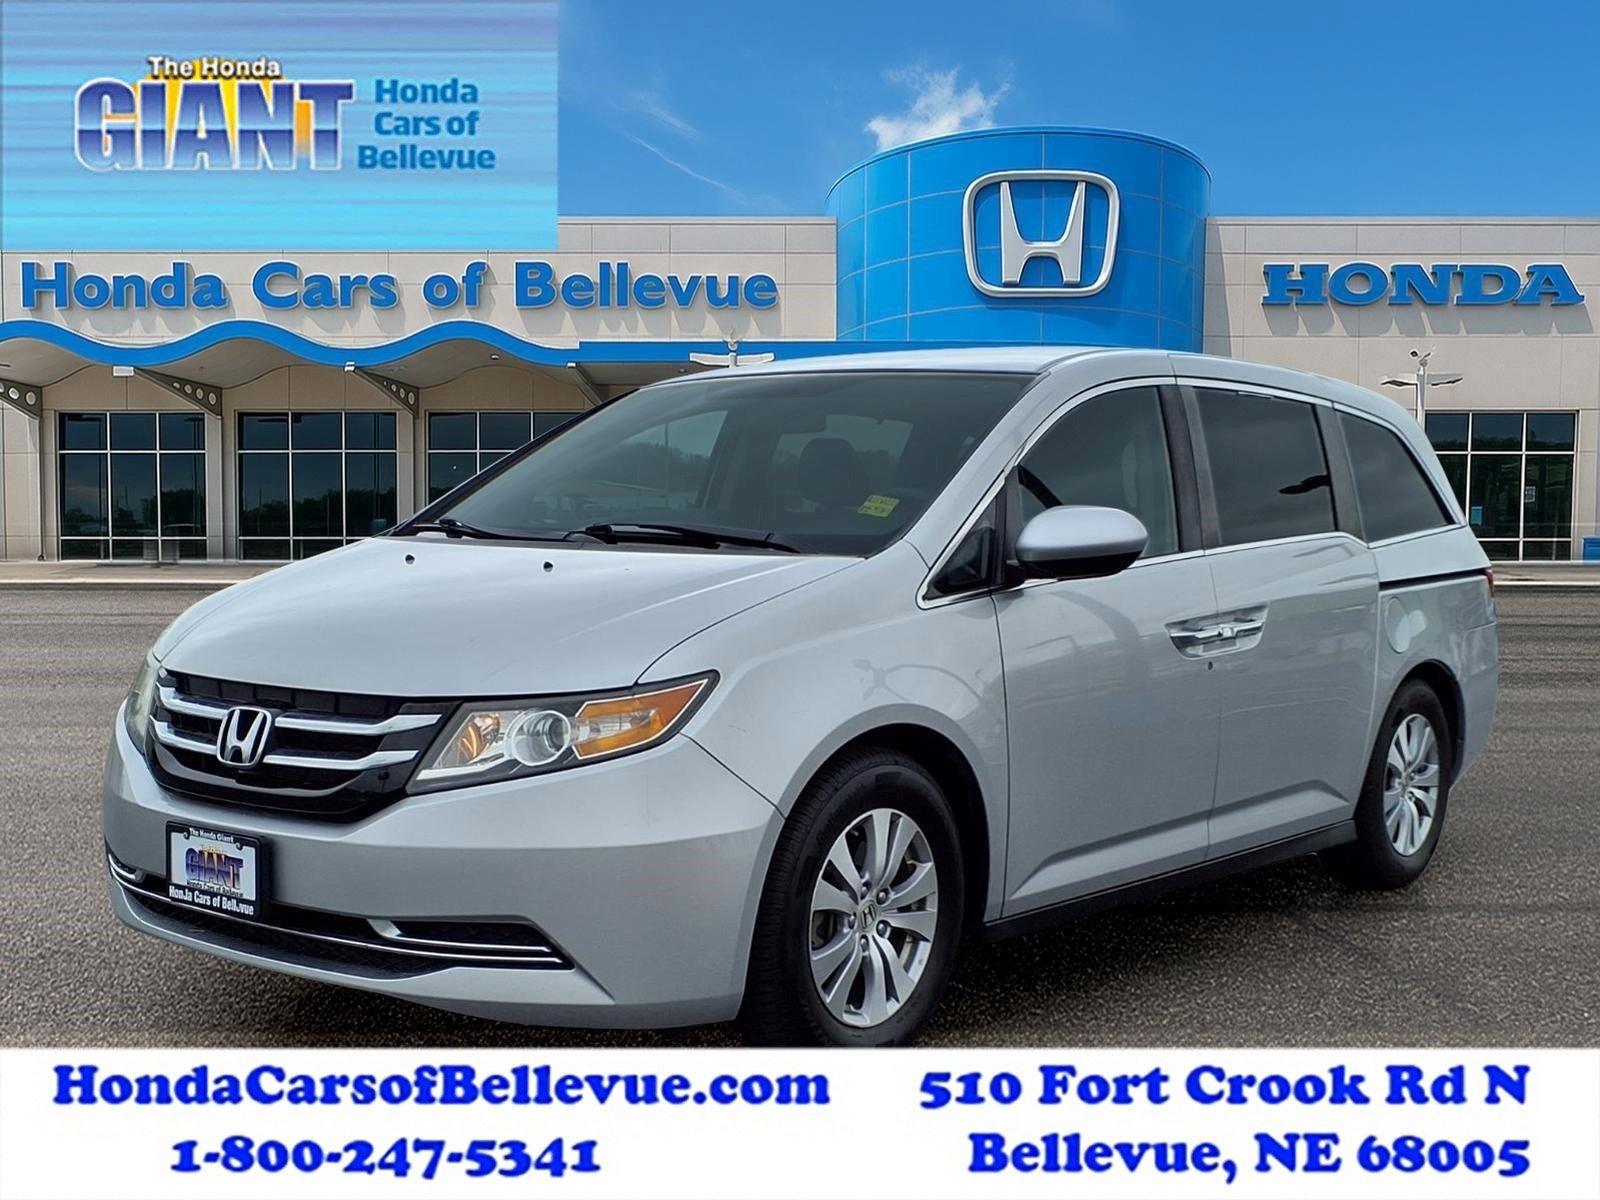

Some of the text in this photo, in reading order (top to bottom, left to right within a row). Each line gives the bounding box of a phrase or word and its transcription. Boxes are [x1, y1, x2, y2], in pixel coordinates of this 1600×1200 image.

[21, 261, 778, 310] Honda Cars of Bellevue
[1262, 262, 1585, 306] HONDA
[185, 847, 243, 890] GIANT
[194, 890, 211, 906] Cars
[212, 895, 221, 908] of
